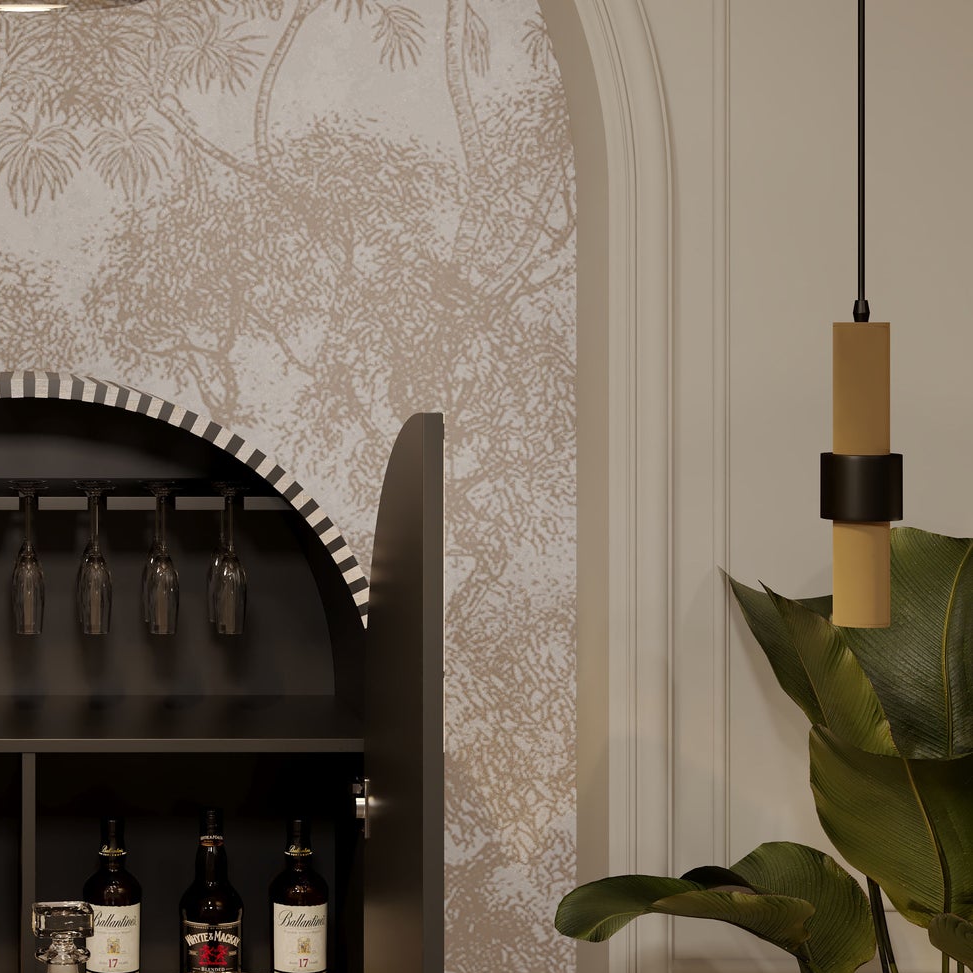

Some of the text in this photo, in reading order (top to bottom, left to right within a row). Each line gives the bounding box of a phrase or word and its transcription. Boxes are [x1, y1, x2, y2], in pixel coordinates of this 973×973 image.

[185, 932, 209, 946] WHYTE
[214, 930, 240, 947] MACKAY
[108, 958, 118, 968] 17
[299, 958, 309, 968] 17
